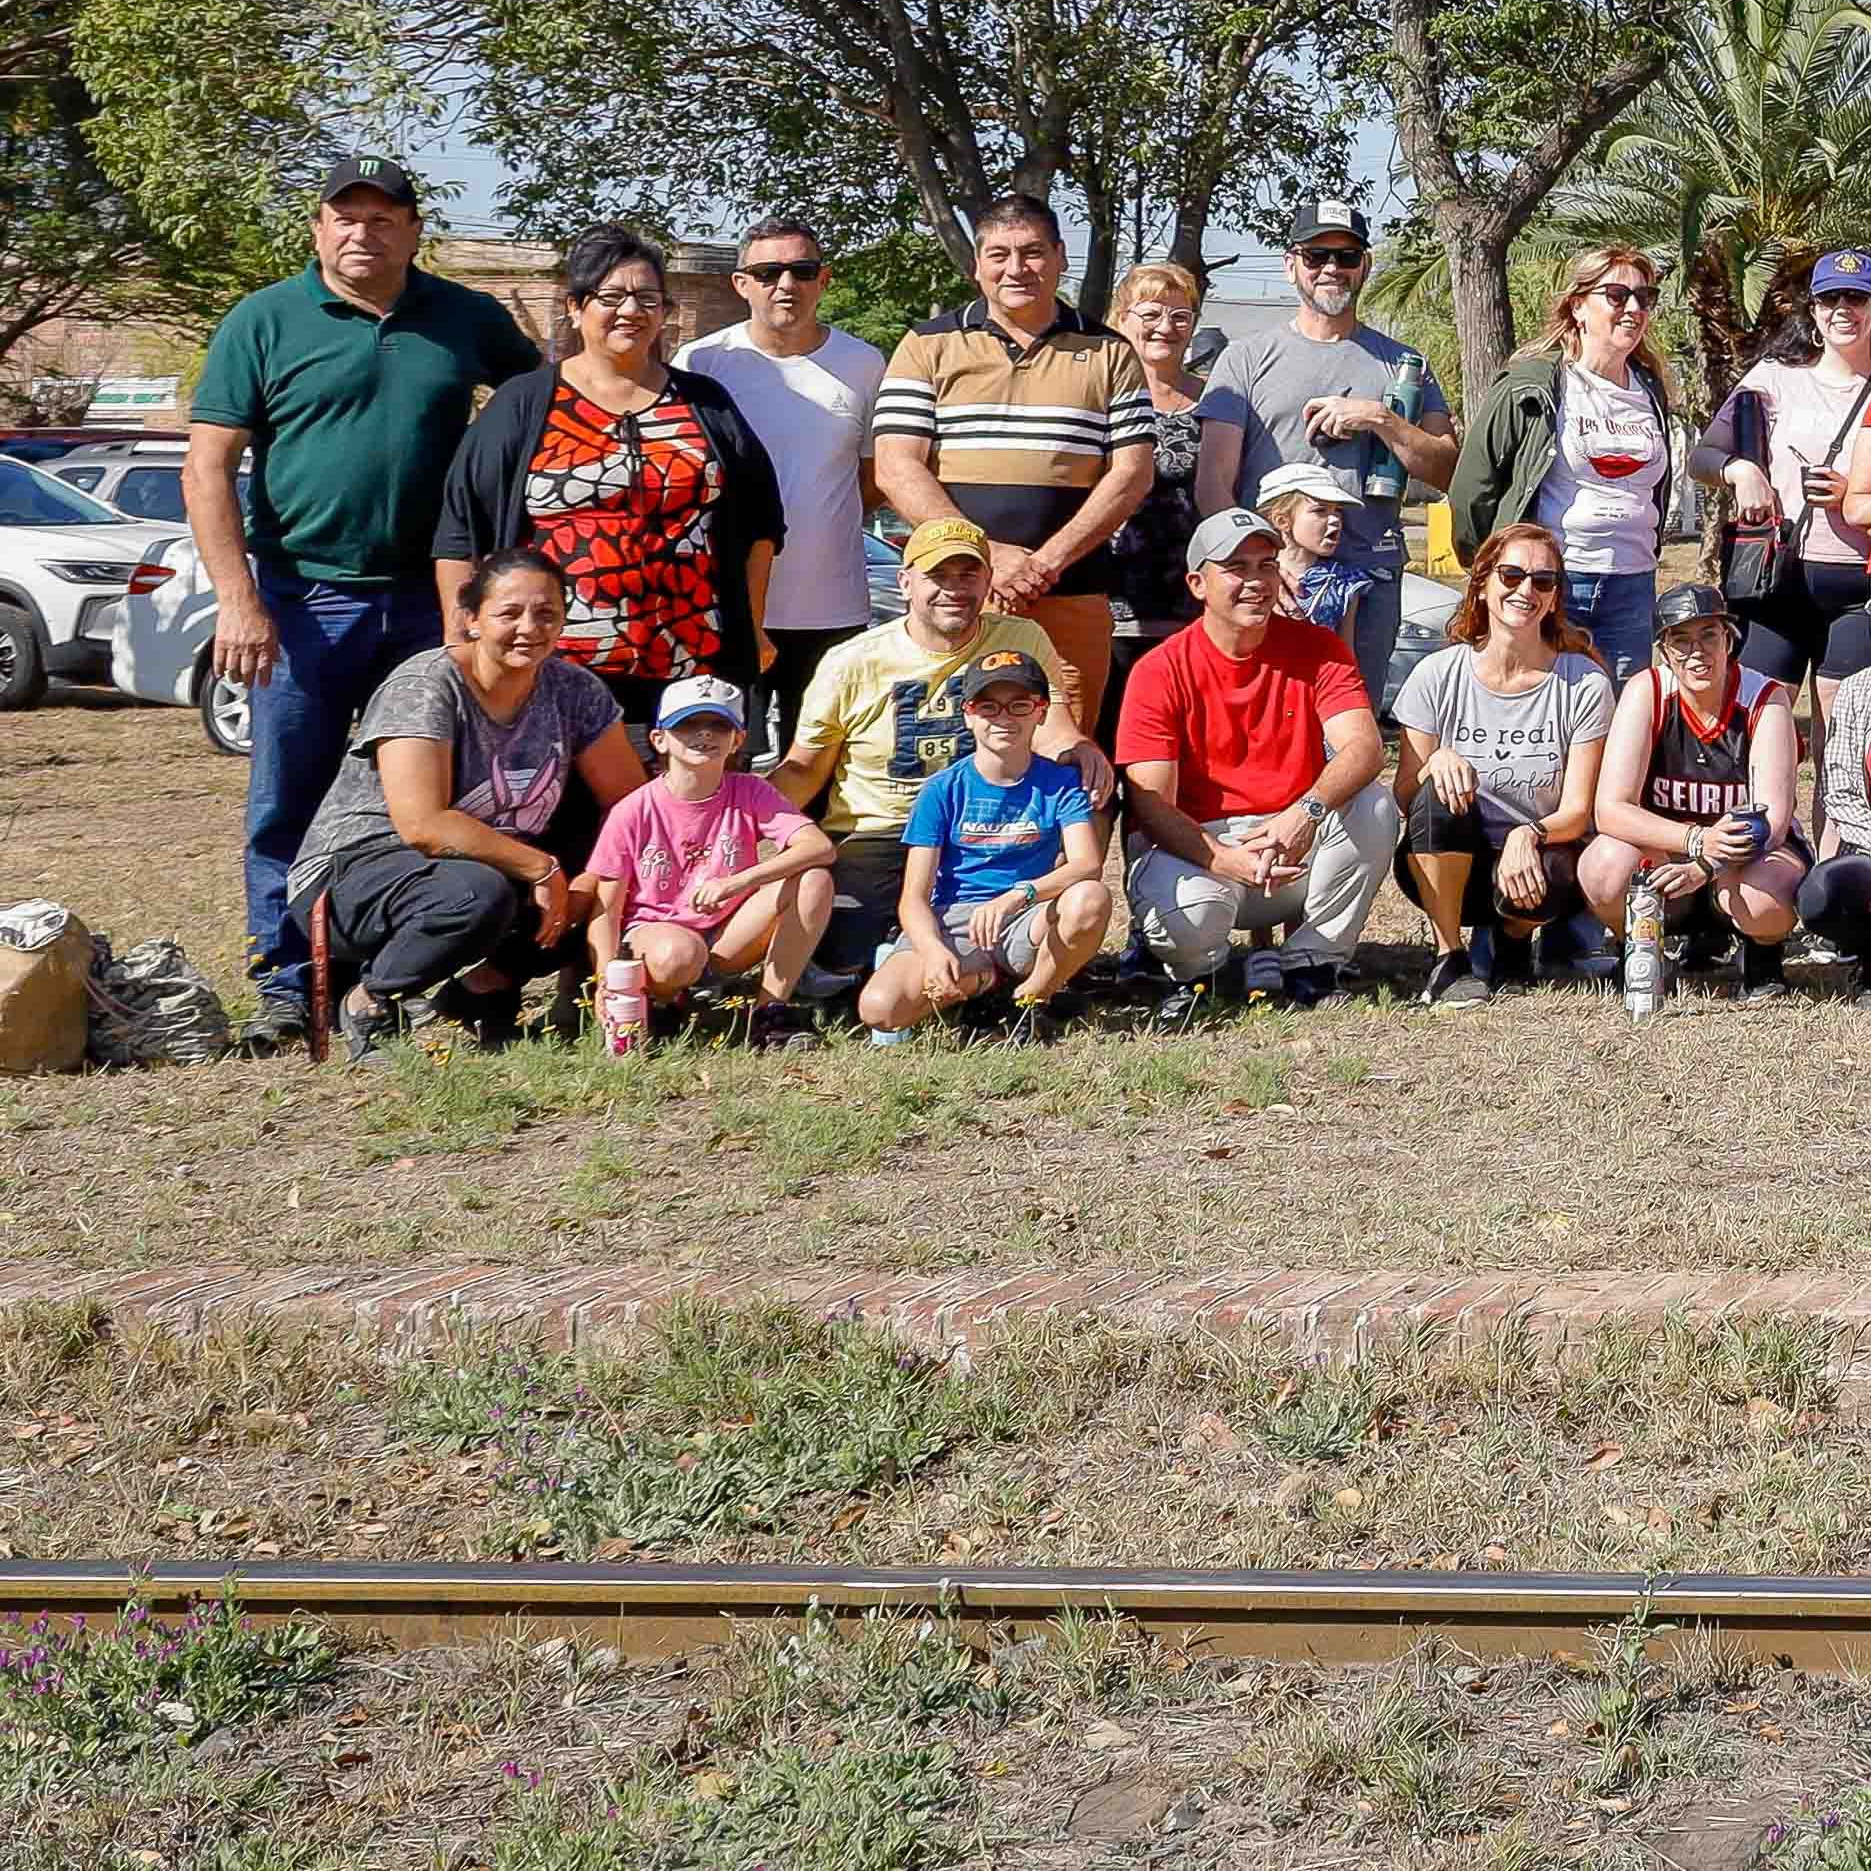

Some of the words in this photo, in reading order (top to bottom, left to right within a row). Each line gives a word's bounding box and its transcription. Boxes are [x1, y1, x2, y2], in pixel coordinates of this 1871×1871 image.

[981, 651, 1024, 671] OK
[1455, 719, 1487, 744] be
[1497, 720, 1556, 745] real
[924, 738, 951, 757] 85
[961, 820, 1039, 833] NAUTICA
